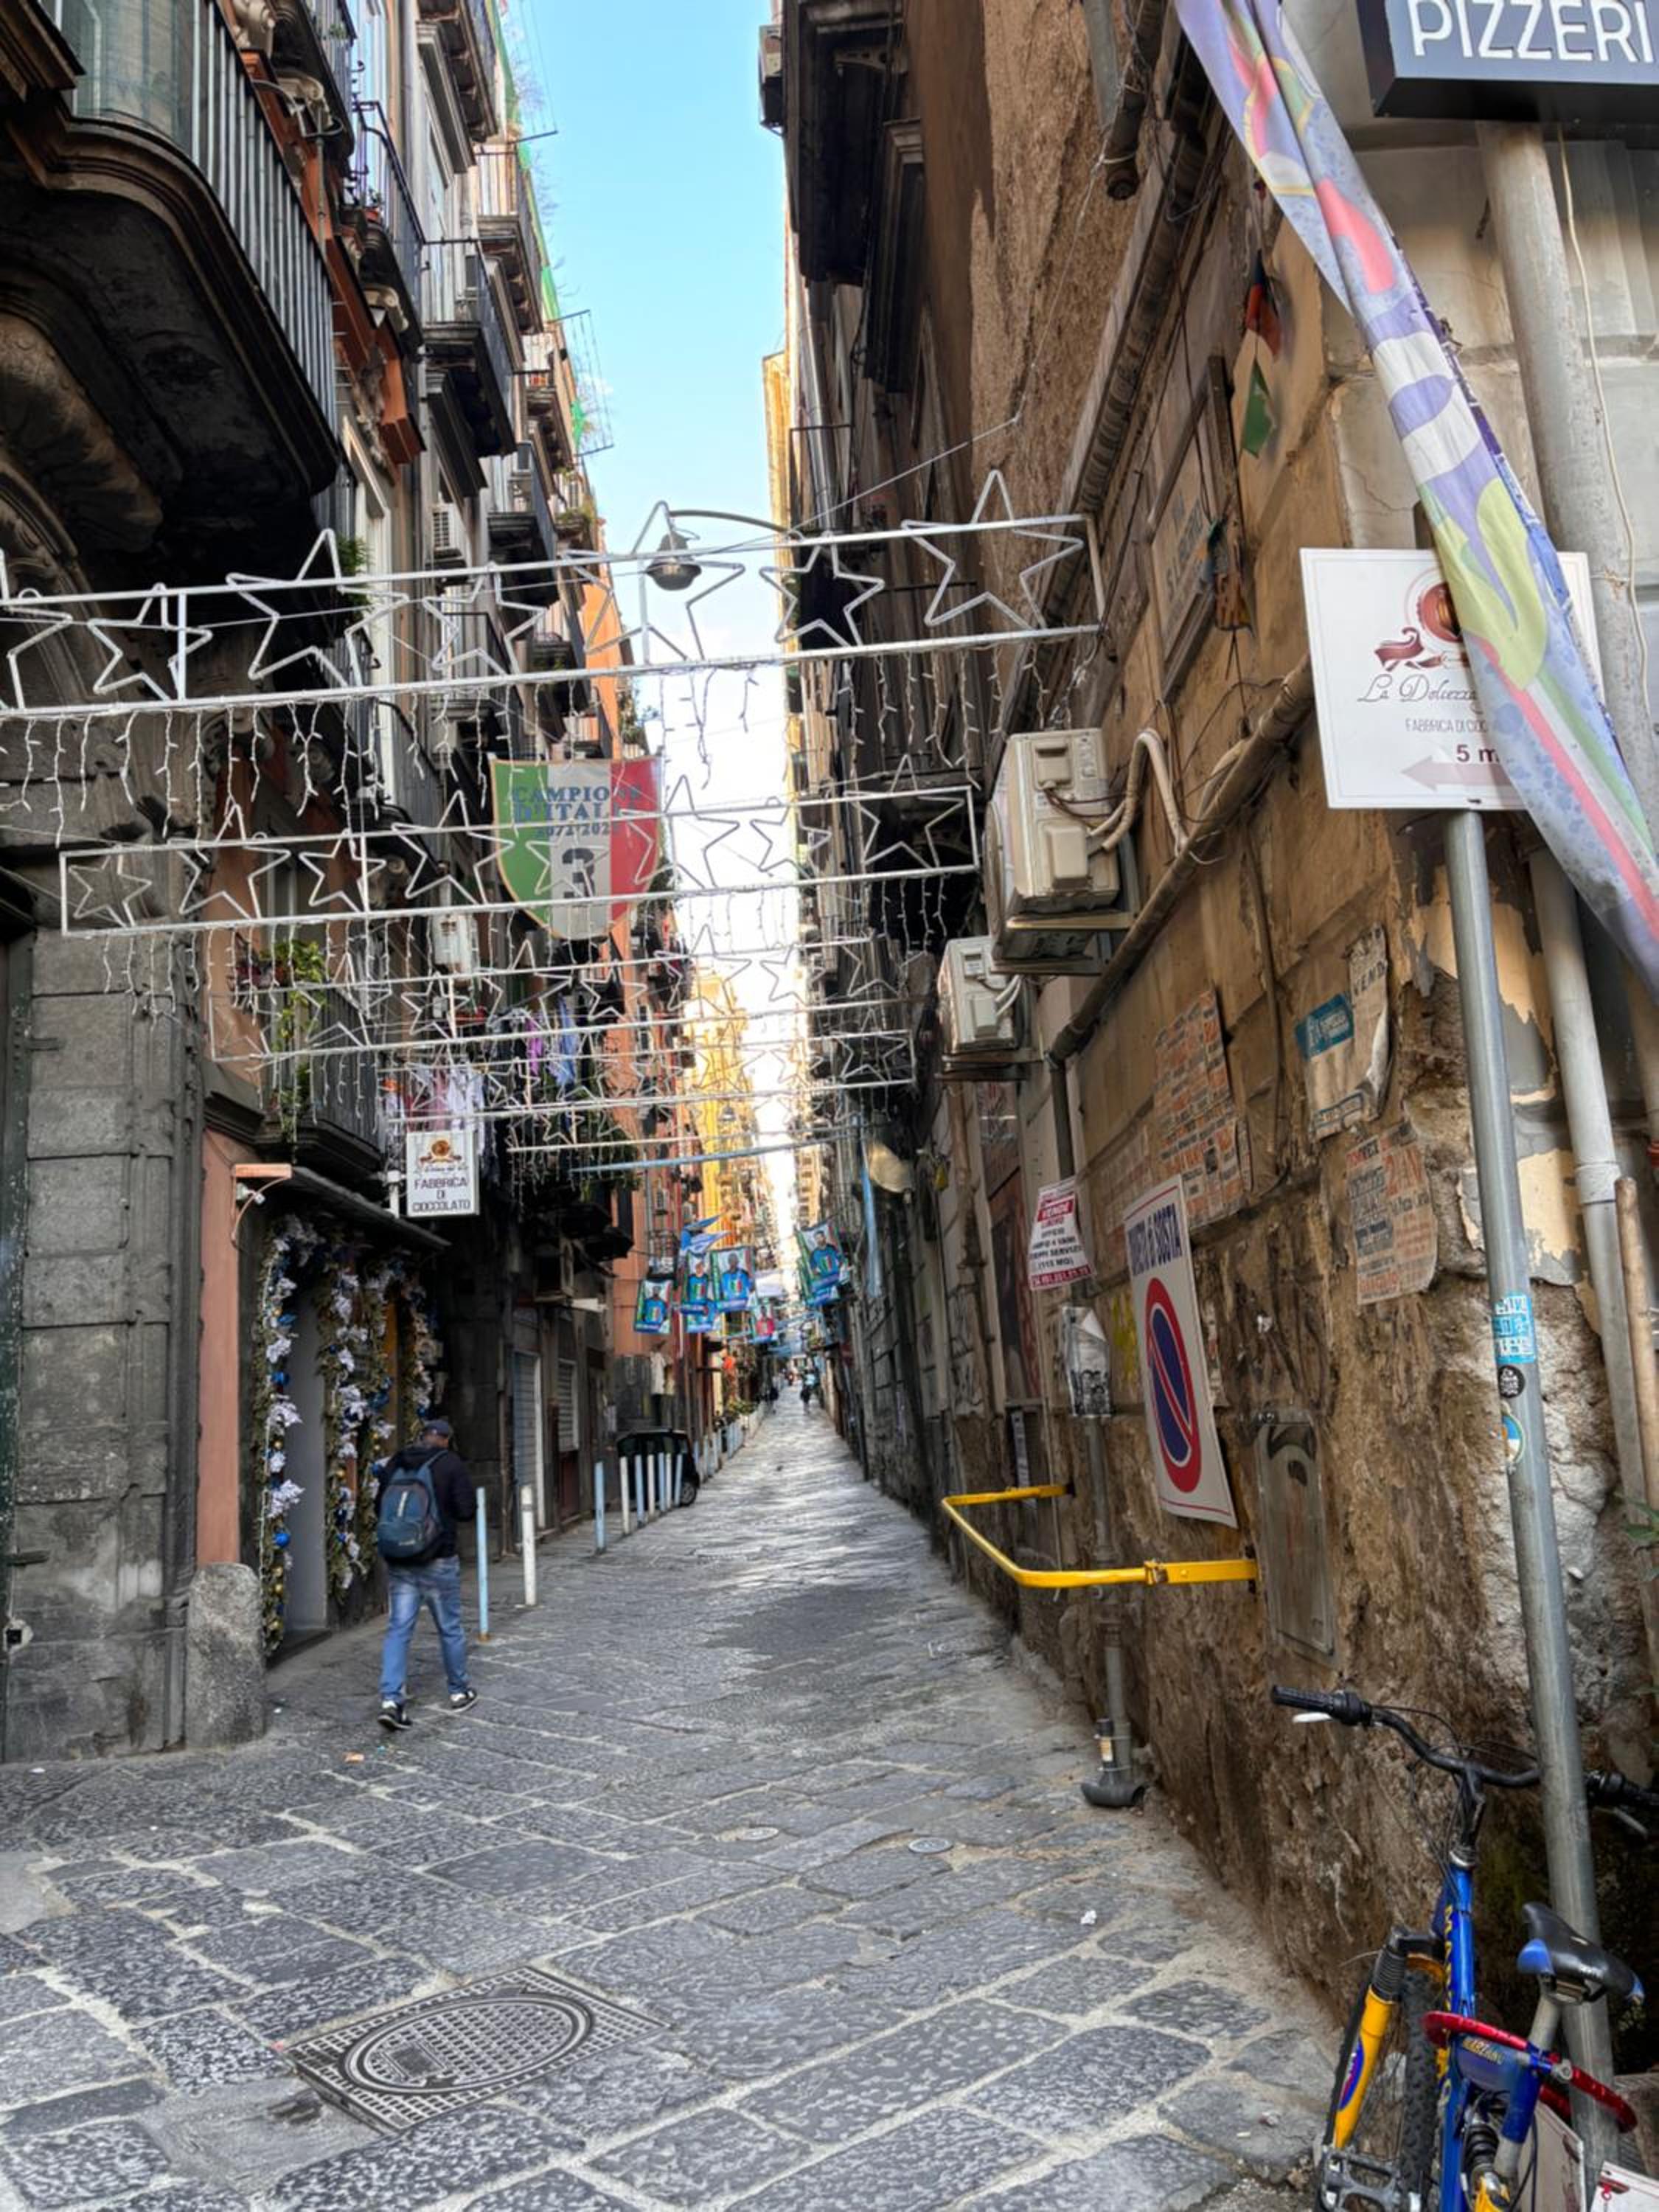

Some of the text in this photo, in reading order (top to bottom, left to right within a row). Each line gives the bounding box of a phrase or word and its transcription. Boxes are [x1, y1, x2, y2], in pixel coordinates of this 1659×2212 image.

[1408, 0, 1654, 63] PIZZERI
[1357, 674, 1393, 702] La
[1456, 743, 1471, 763] 5
[414, 1177, 467, 1190] FABBRICA
[412, 1199, 471, 1212] CIOCCOLATO
